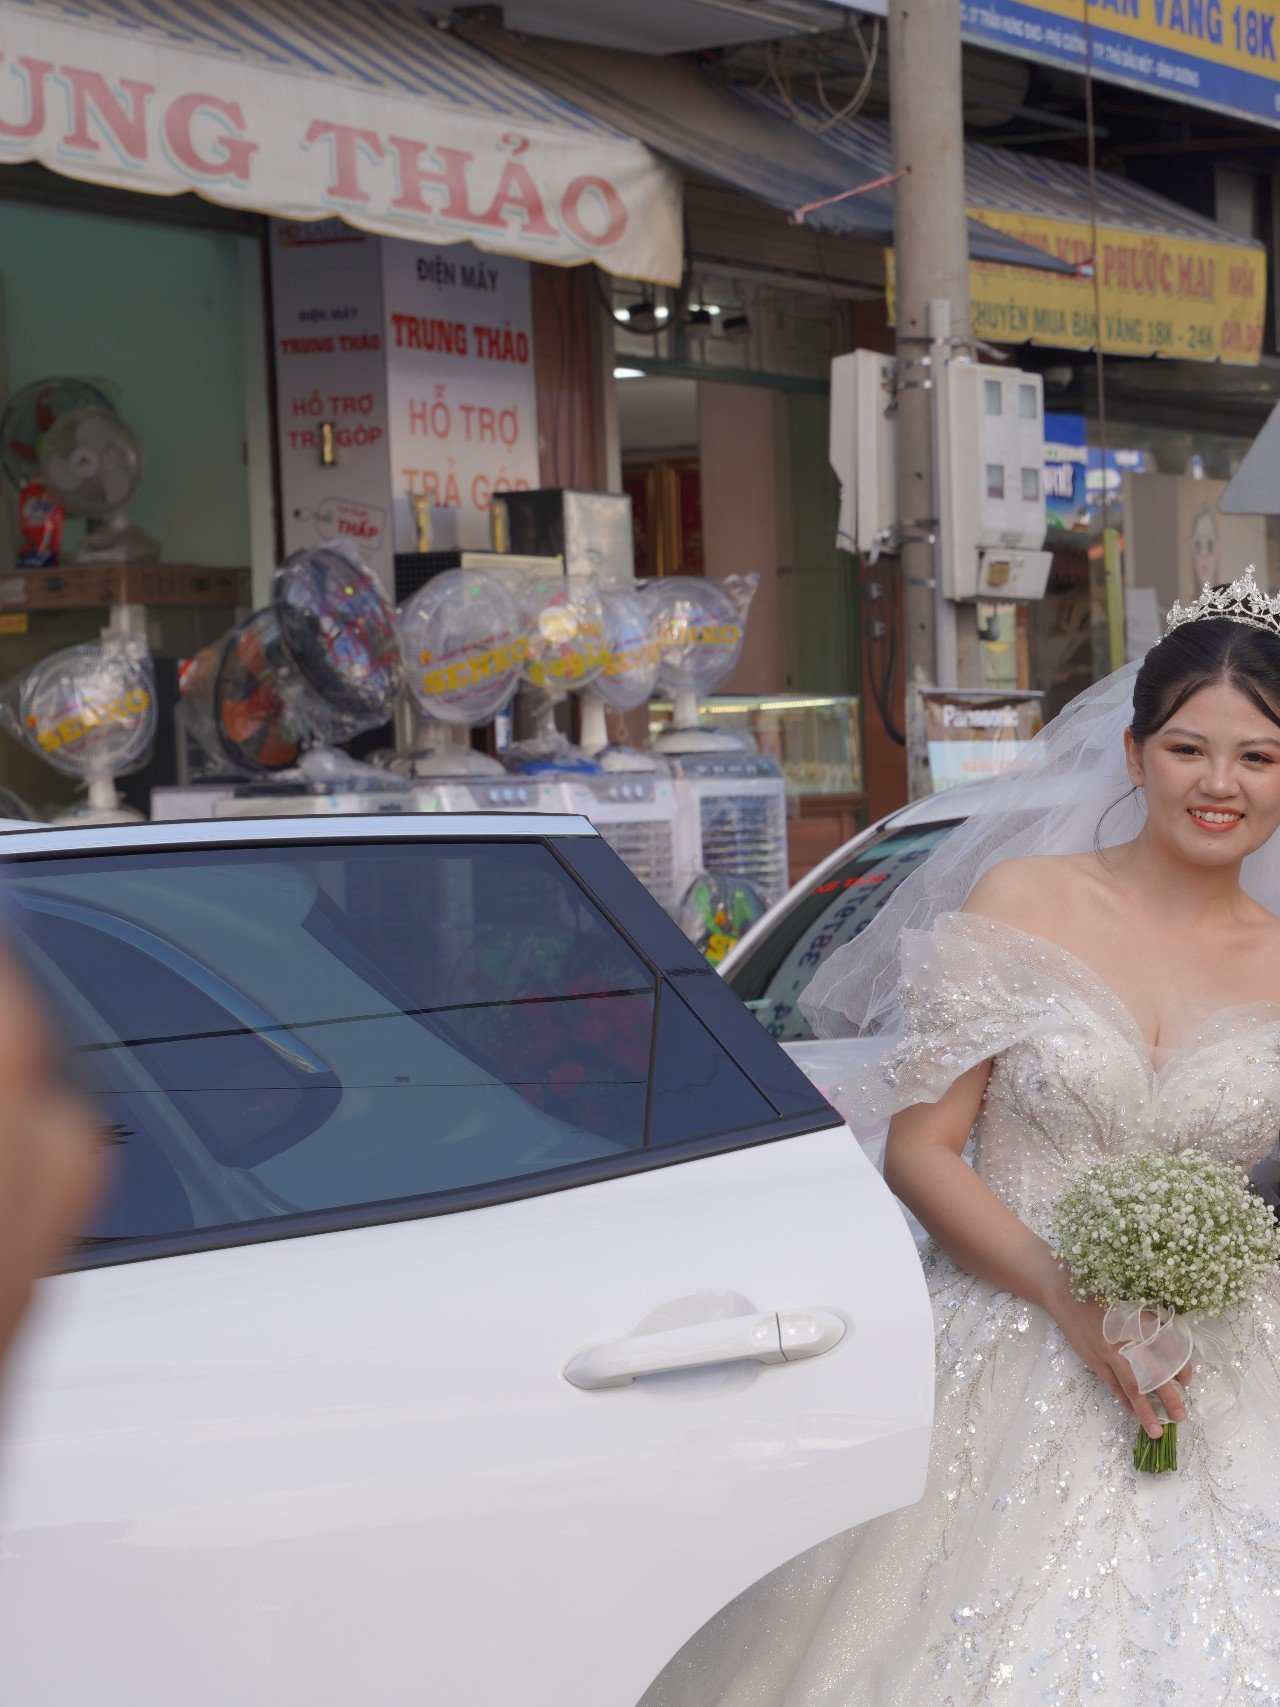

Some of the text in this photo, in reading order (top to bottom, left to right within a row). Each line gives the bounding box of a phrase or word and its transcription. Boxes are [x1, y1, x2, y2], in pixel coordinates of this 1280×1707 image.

[1233, 6, 1276, 62] 18K
[304, 118, 628, 247] THẢO
[416, 254, 498, 293] ĐIỆN MÁY
[281, 329, 381, 356] TRUNG THẢO
[391, 313, 529, 364] TRUNG THẢO
[1033, 306, 1065, 334] MUA
[1106, 309, 1143, 344] VÀNG
[291, 389, 375, 417] HỖ TRỢ
[409, 384, 519, 453] HỖ TRỢ
[336, 424, 382, 448] GÓP
[402, 456, 462, 509] TRẢ
